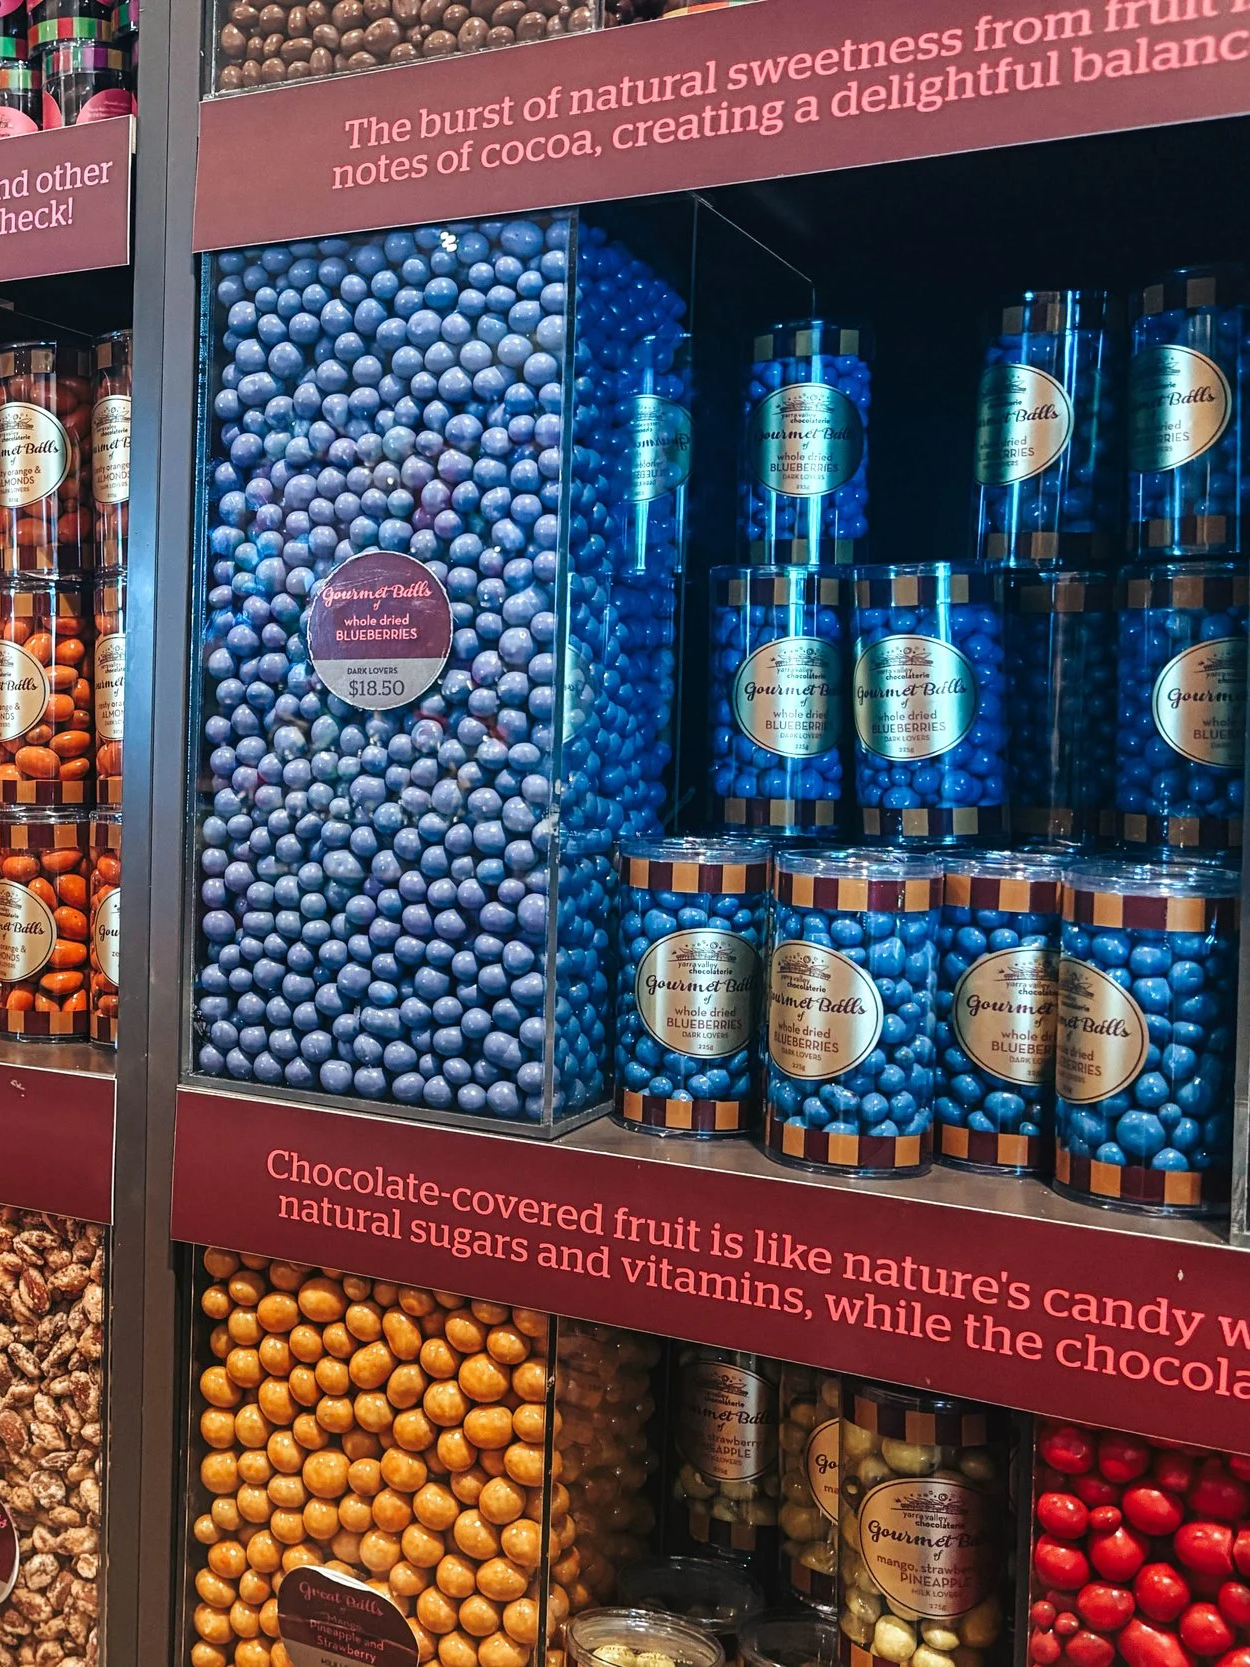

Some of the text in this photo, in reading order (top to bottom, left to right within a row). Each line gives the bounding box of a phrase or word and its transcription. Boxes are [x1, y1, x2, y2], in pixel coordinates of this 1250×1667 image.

[345, 116, 412, 150] The
[419, 96, 515, 139] burst
[523, 85, 563, 122] of
[569, 60, 717, 116] natural
[727, 28, 963, 91] sweetness
[973, 8, 1093, 62] from
[331, 30, 1250, 190] notes of cocoa, creating a delightful balanc
[35, 161, 113, 194] other
[322, 580, 432, 608] Gourmet Balls
[344, 614, 410, 627] whole dried
[336, 628, 418, 641] BLUEBERRIES
[347, 667, 398, 675] DARK LOVERS
[7, 677, 38, 692] Balls
[349, 680, 405, 698] $18.50
[645, 974, 721, 996] Gourmet
[674, 1007, 736, 1018] whole dried
[818, 997, 868, 1016] Balls
[667, 1018, 742, 1030] BLUEBERRIES
[681, 1031, 729, 1040] DARK LOVERS
[774, 1032, 839, 1054] BLUEBERRIES
[267, 1149, 604, 1236] Chocolate-covered
[613, 1207, 701, 1253] fruit
[709, 1222, 743, 1259] is
[753, 1229, 833, 1275] like
[842, 1252, 1031, 1310] nature's
[1043, 1289, 1206, 1347] candy
[278, 1195, 402, 1240] natural
[410, 1219, 528, 1262] sugars
[537, 1243, 611, 1279] and
[620, 1254, 813, 1320] vitamins,
[824, 1292, 952, 1342] while
[963, 1313, 1043, 1360] the
[867, 1519, 953, 1549] Gourmet
[299, 1580, 384, 1617] Great Balls
